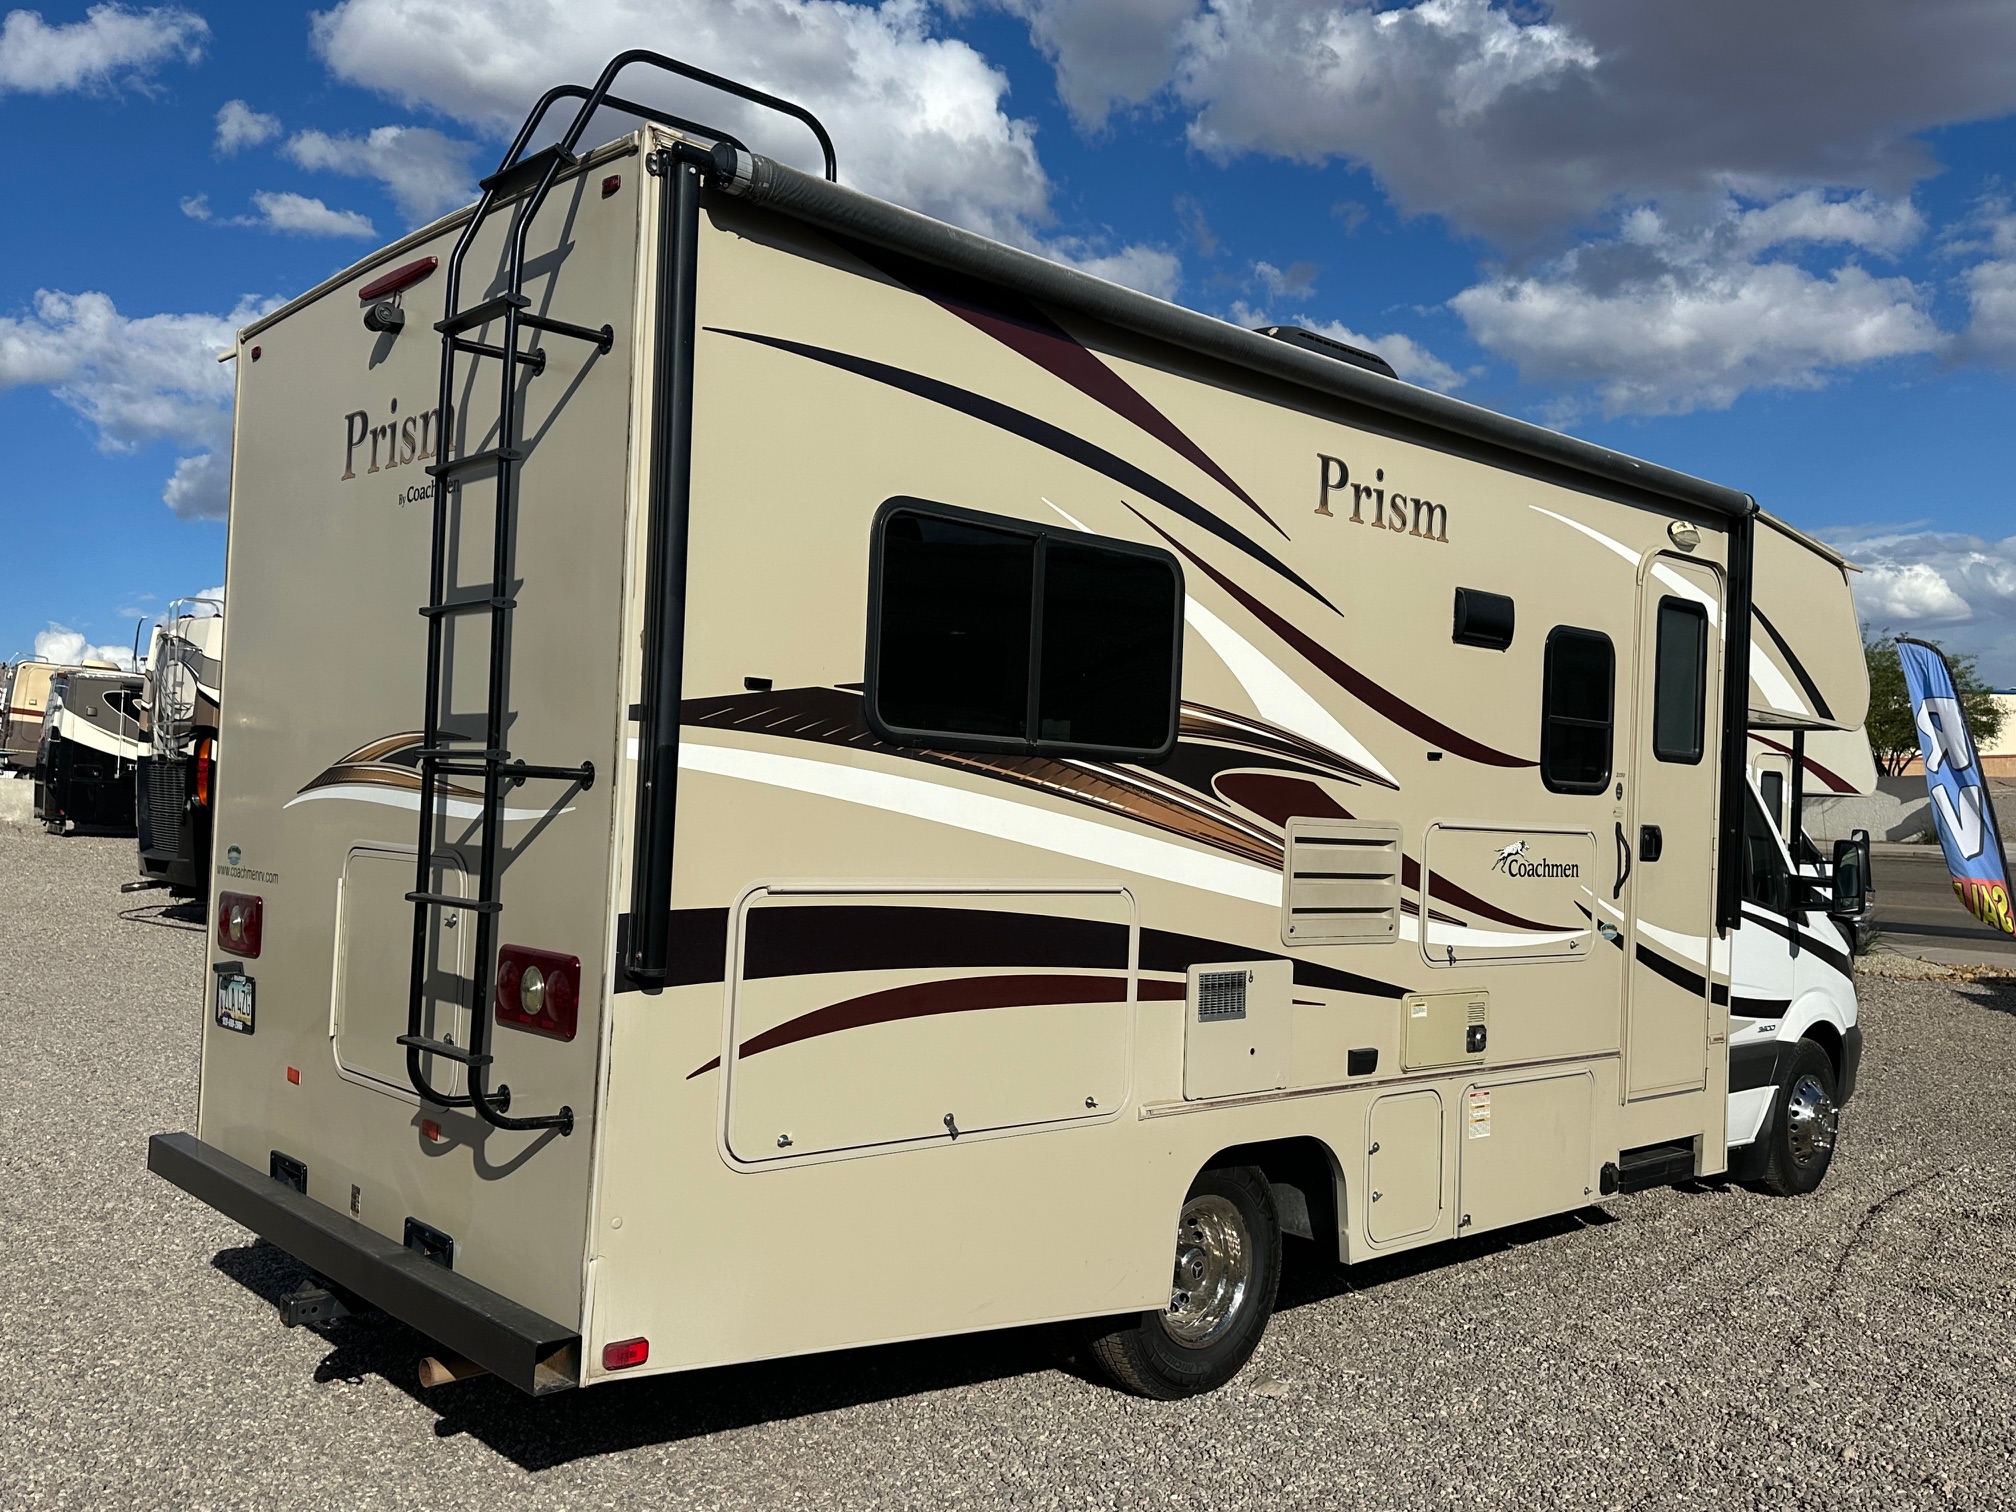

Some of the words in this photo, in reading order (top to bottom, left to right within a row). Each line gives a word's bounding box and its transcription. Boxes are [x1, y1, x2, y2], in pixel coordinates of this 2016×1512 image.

[398, 493, 406, 508] By
[1314, 453, 1449, 543] Prism
[216, 865, 279, 885] www.coachmenrv.com
[1508, 857, 1579, 878] Coachmen
